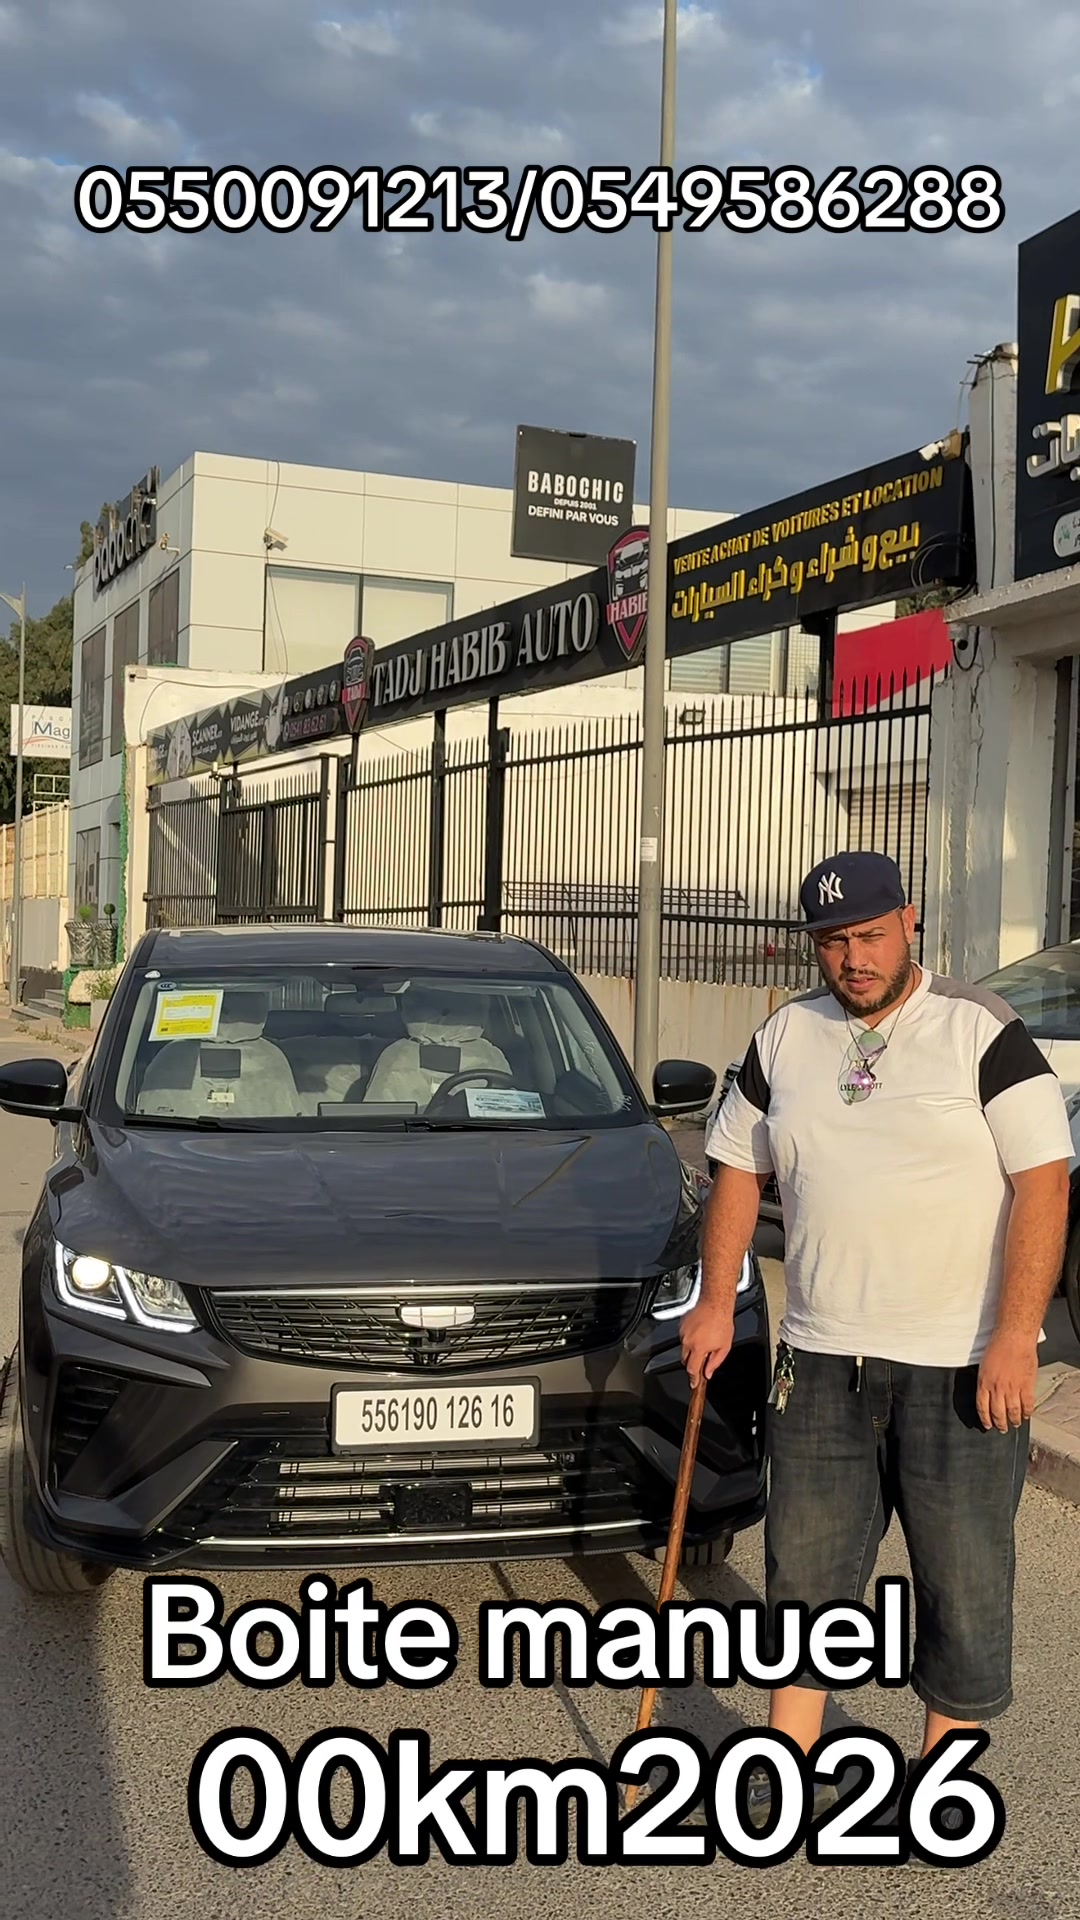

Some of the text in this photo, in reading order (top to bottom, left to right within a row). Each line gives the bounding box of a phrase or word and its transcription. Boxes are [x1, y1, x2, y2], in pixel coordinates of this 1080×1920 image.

[528, 470, 624, 504] BABOCHIC
[528, 505, 619, 526] DEFINI PAR VOUS
[554, 498, 597, 510] DEPUIS 2001
[674, 466, 943, 575] VENTE ACHAT DE VOITURES ET LOCATION
[672, 569, 745, 623] السيارات
[372, 593, 596, 707] TADJ HABIB AUTO
[34, 721, 70, 739] Mag
[192, 724, 219, 747] SCANNER
[230, 710, 260, 733] VIDANGE
[361, 1393, 515, 1433] 556190 126 16
